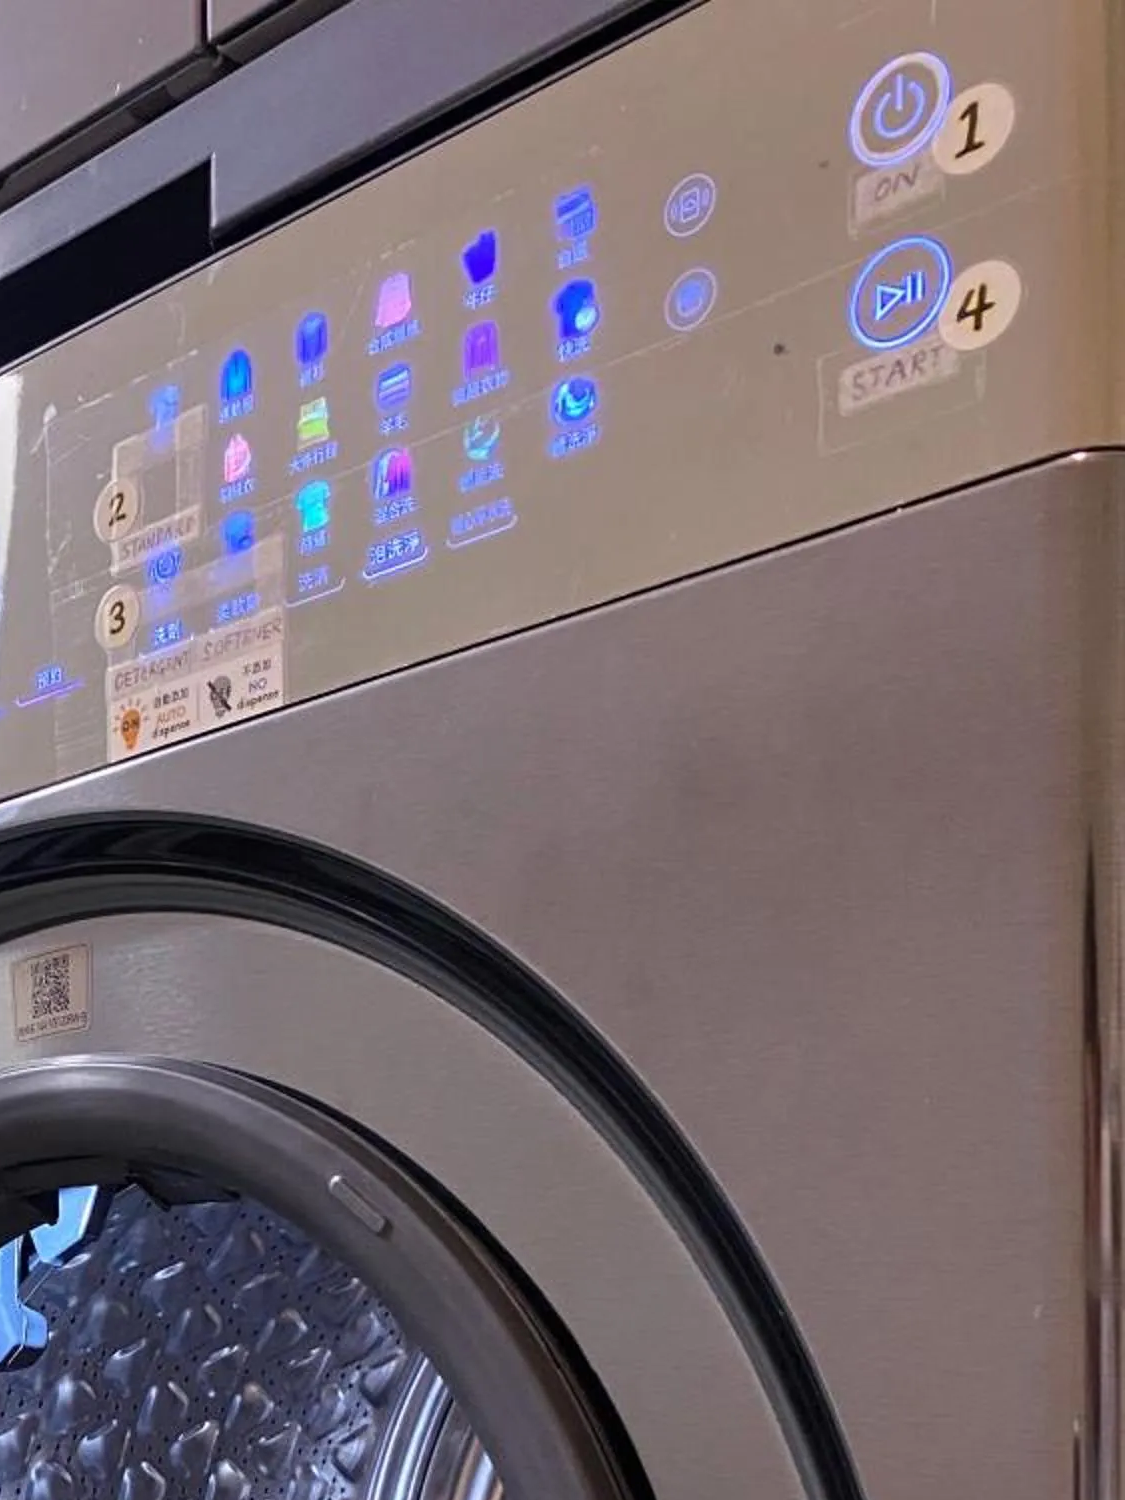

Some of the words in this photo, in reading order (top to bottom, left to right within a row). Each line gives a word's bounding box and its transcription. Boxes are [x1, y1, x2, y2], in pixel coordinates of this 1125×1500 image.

[954, 101, 985, 160] 1
[874, 167, 921, 203] ON
[956, 282, 995, 332] 4
[850, 346, 946, 403] START
[108, 491, 128, 528] 2
[108, 601, 126, 636] 3
[248, 677, 268, 695] NO
[156, 705, 187, 726] AUTO
